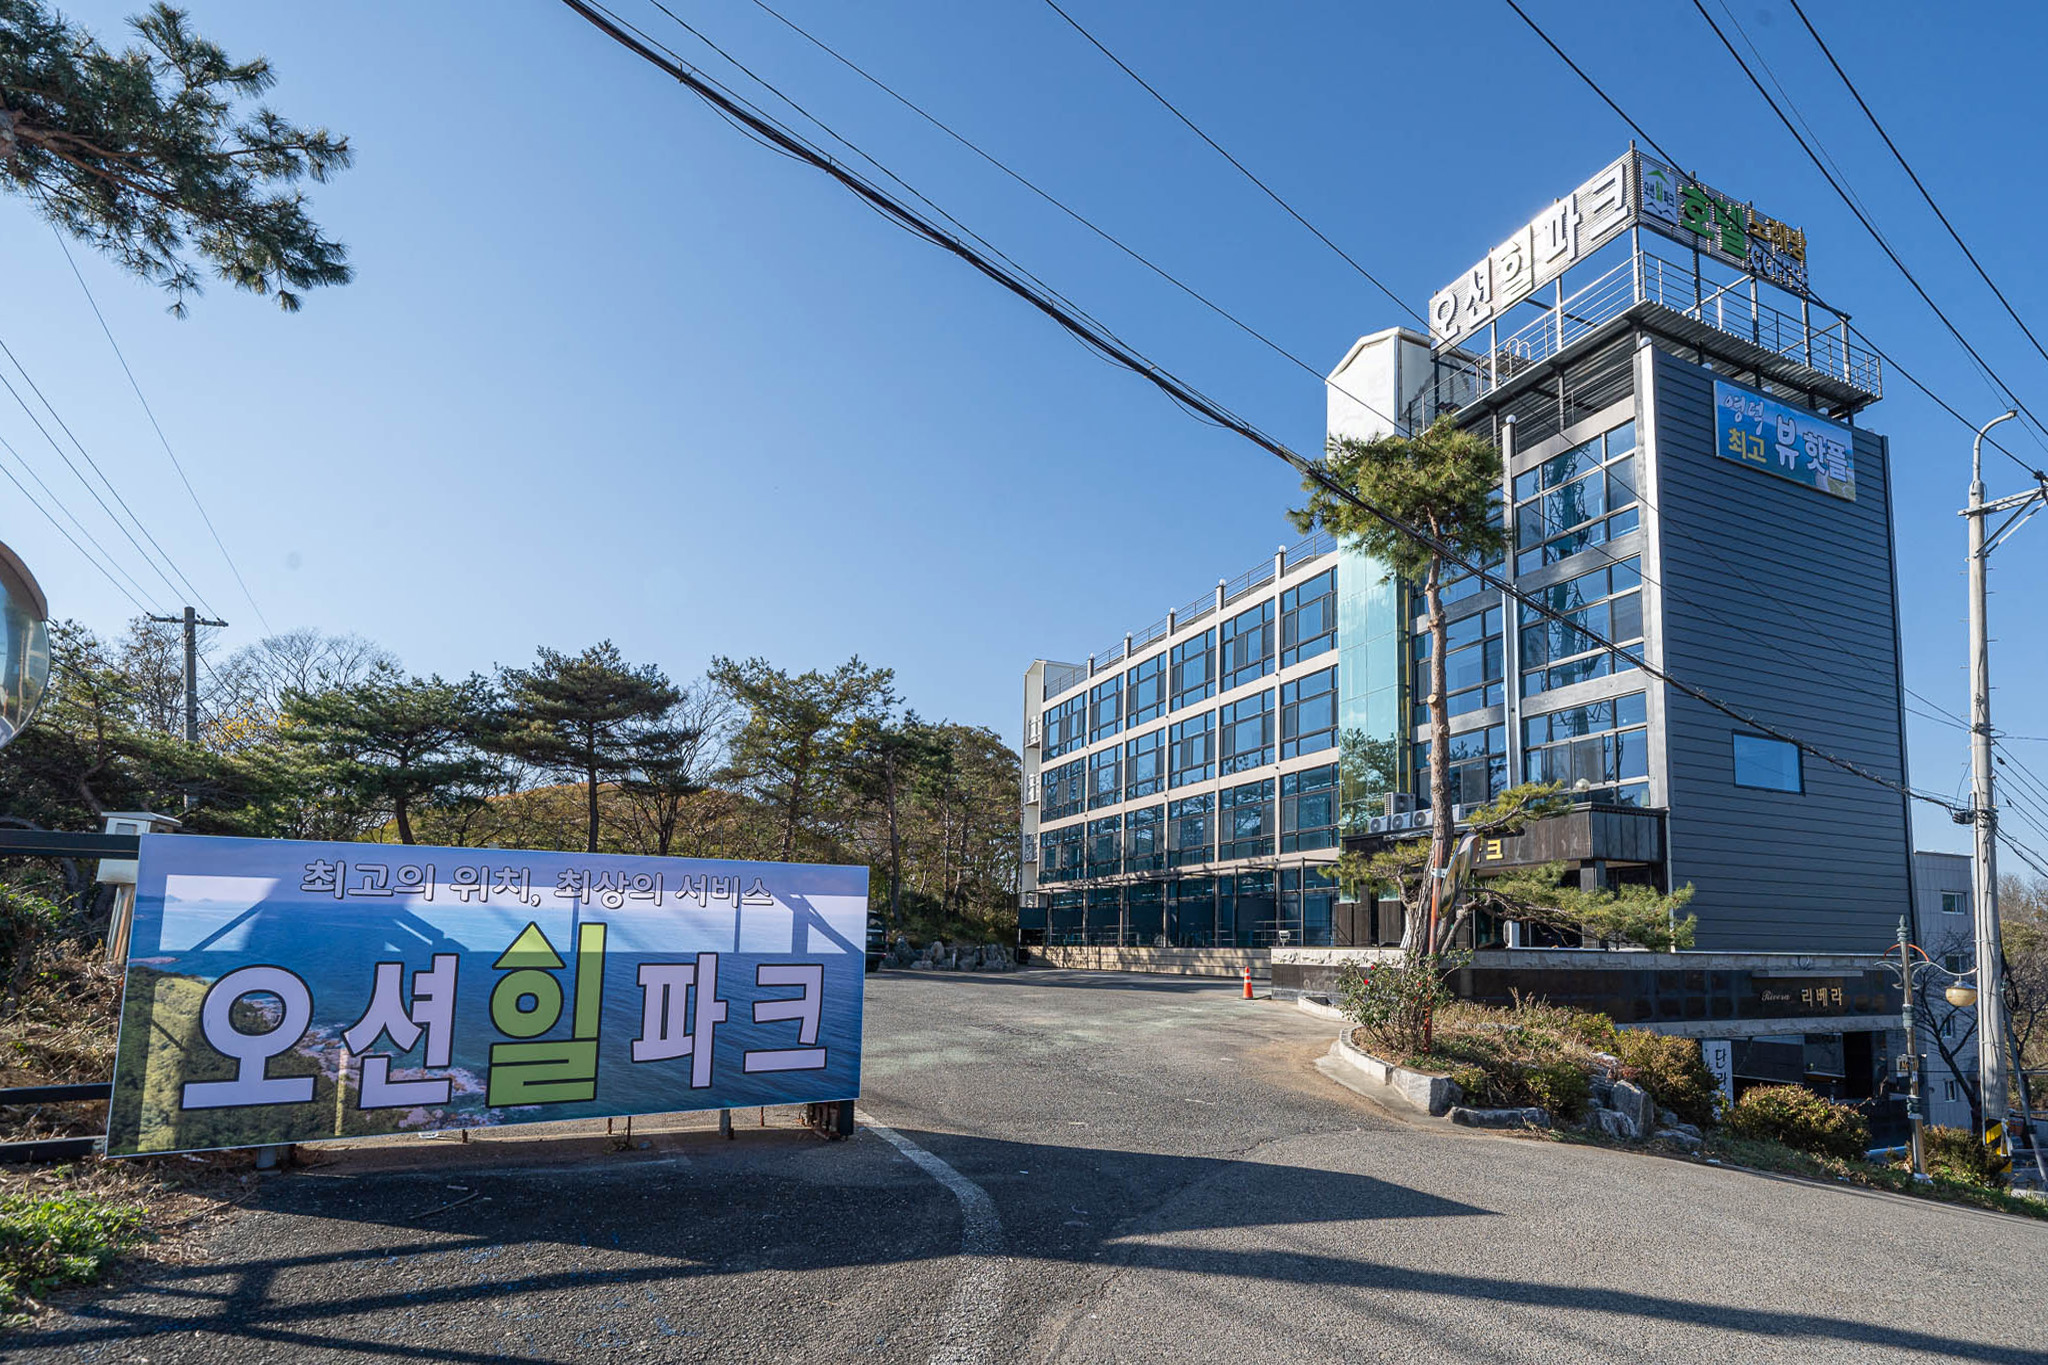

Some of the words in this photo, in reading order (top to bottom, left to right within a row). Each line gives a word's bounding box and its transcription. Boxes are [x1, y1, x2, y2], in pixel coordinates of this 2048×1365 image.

[1679, 184, 1747, 260] 호텔
[1750, 209, 1807, 261] 노래방
[1432, 163, 1630, 350] 오션힐파크
[1750, 244, 1808, 291] COFFEE
[1724, 394, 1765, 436] 영덕
[1728, 427, 1767, 463] 최고
[1775, 414, 1799, 470] 뷰
[1803, 431, 1848, 482] 핫플
[300, 859, 435, 901] 최고의
[449, 865, 541, 907] 위치,
[554, 868, 664, 909] 최상의
[675, 873, 774, 908] 서비스
[1801, 986, 1843, 1008] 리베라
